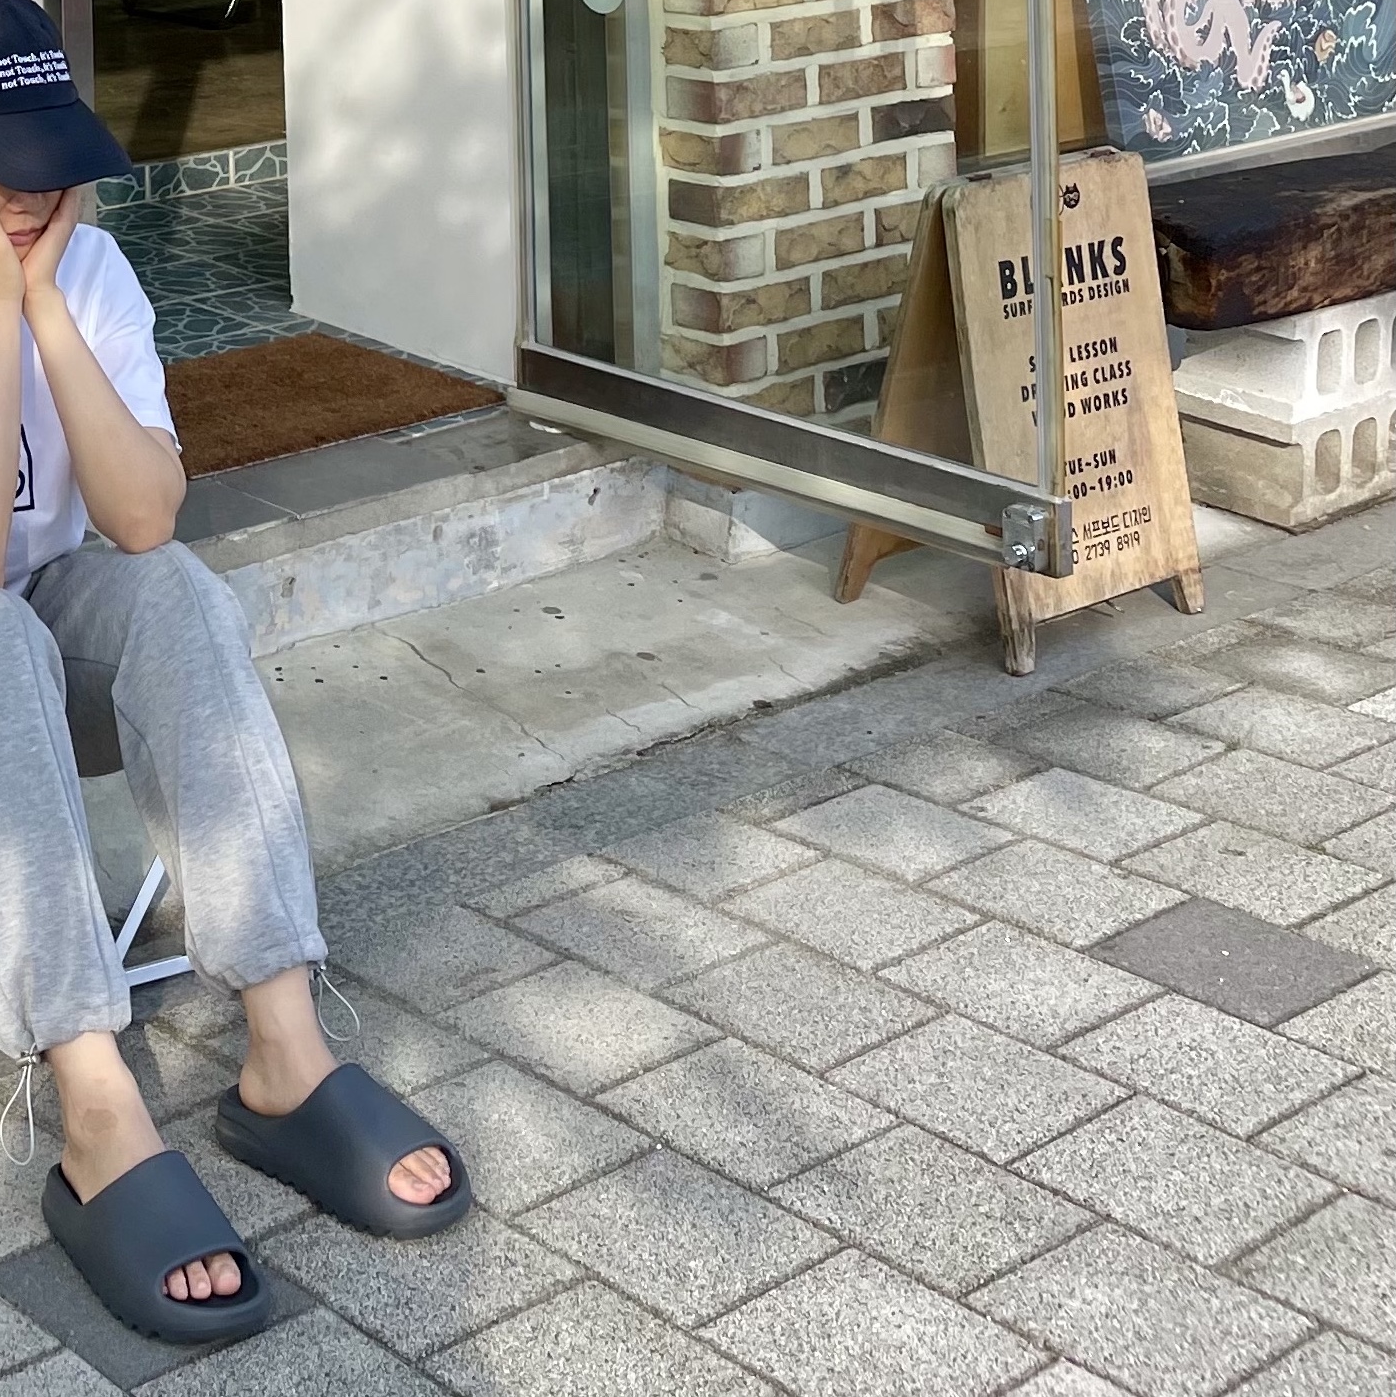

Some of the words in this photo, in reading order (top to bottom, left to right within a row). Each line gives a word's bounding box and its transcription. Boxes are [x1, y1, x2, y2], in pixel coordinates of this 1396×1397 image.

[0, 67, 16, 78] not
[1, 78, 18, 90] not
[998, 236, 1127, 301] BLNKS
[1003, 288, 1084, 320] SURFRDS
[1088, 278, 1130, 301] DESIGN
[1069, 336, 1118, 363] LESSON
[1093, 359, 1132, 385] CLASS
[1080, 387, 1128, 415] WORKS
[1067, 469, 1133, 500] :00~19:00
[1082, 514, 1121, 542] 서프보드
[1122, 504, 1152, 529] 디자인
[1085, 539, 1110, 561] 2739
[1116, 530, 1141, 552] 8919
